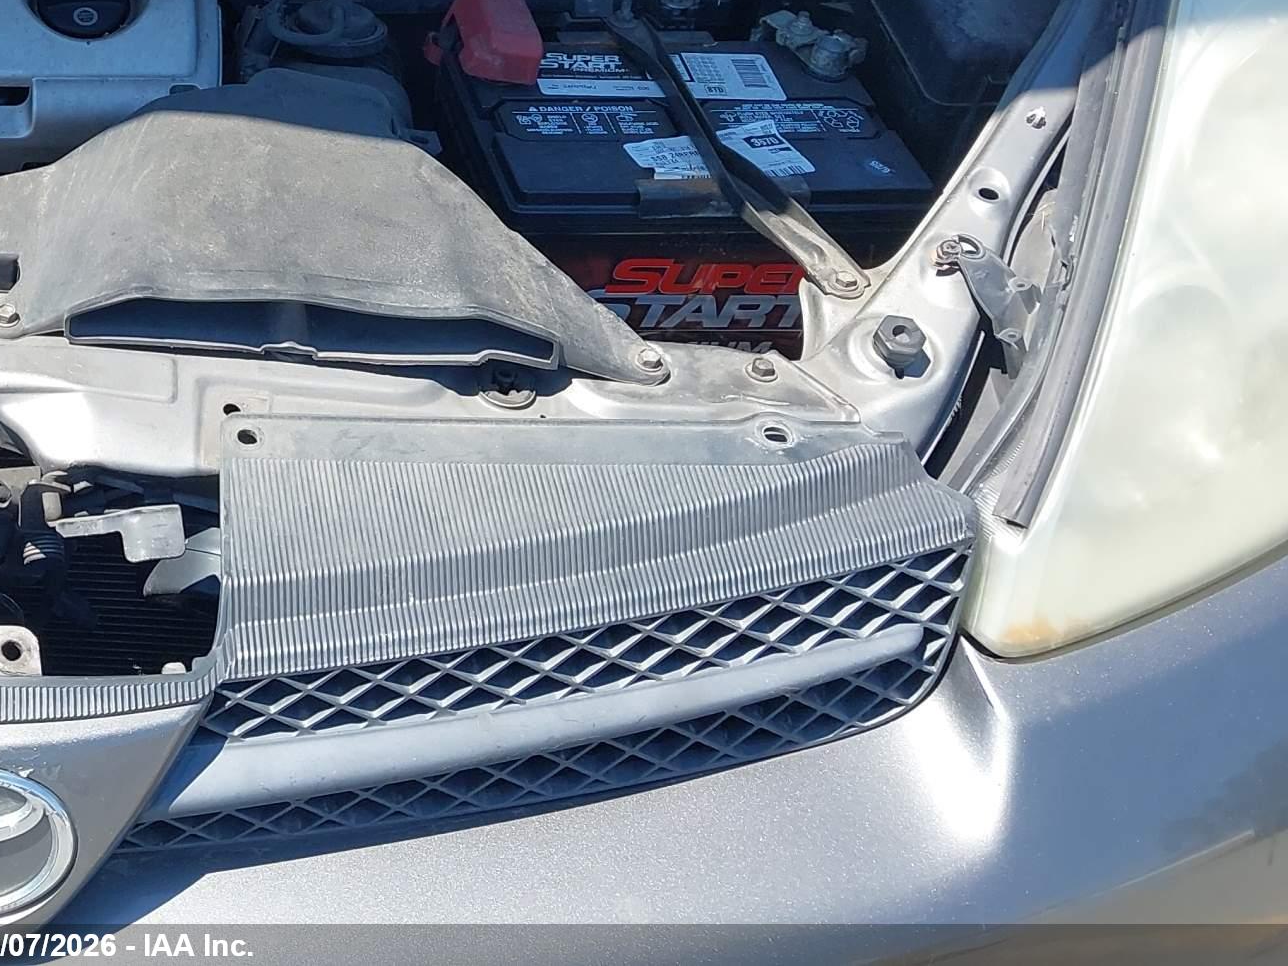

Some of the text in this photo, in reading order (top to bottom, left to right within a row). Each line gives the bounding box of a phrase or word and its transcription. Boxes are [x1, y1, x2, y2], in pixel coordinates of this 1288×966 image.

[545, 52, 620, 62] SUPER
[539, 59, 623, 69] START
[750, 136, 780, 147] 3570
